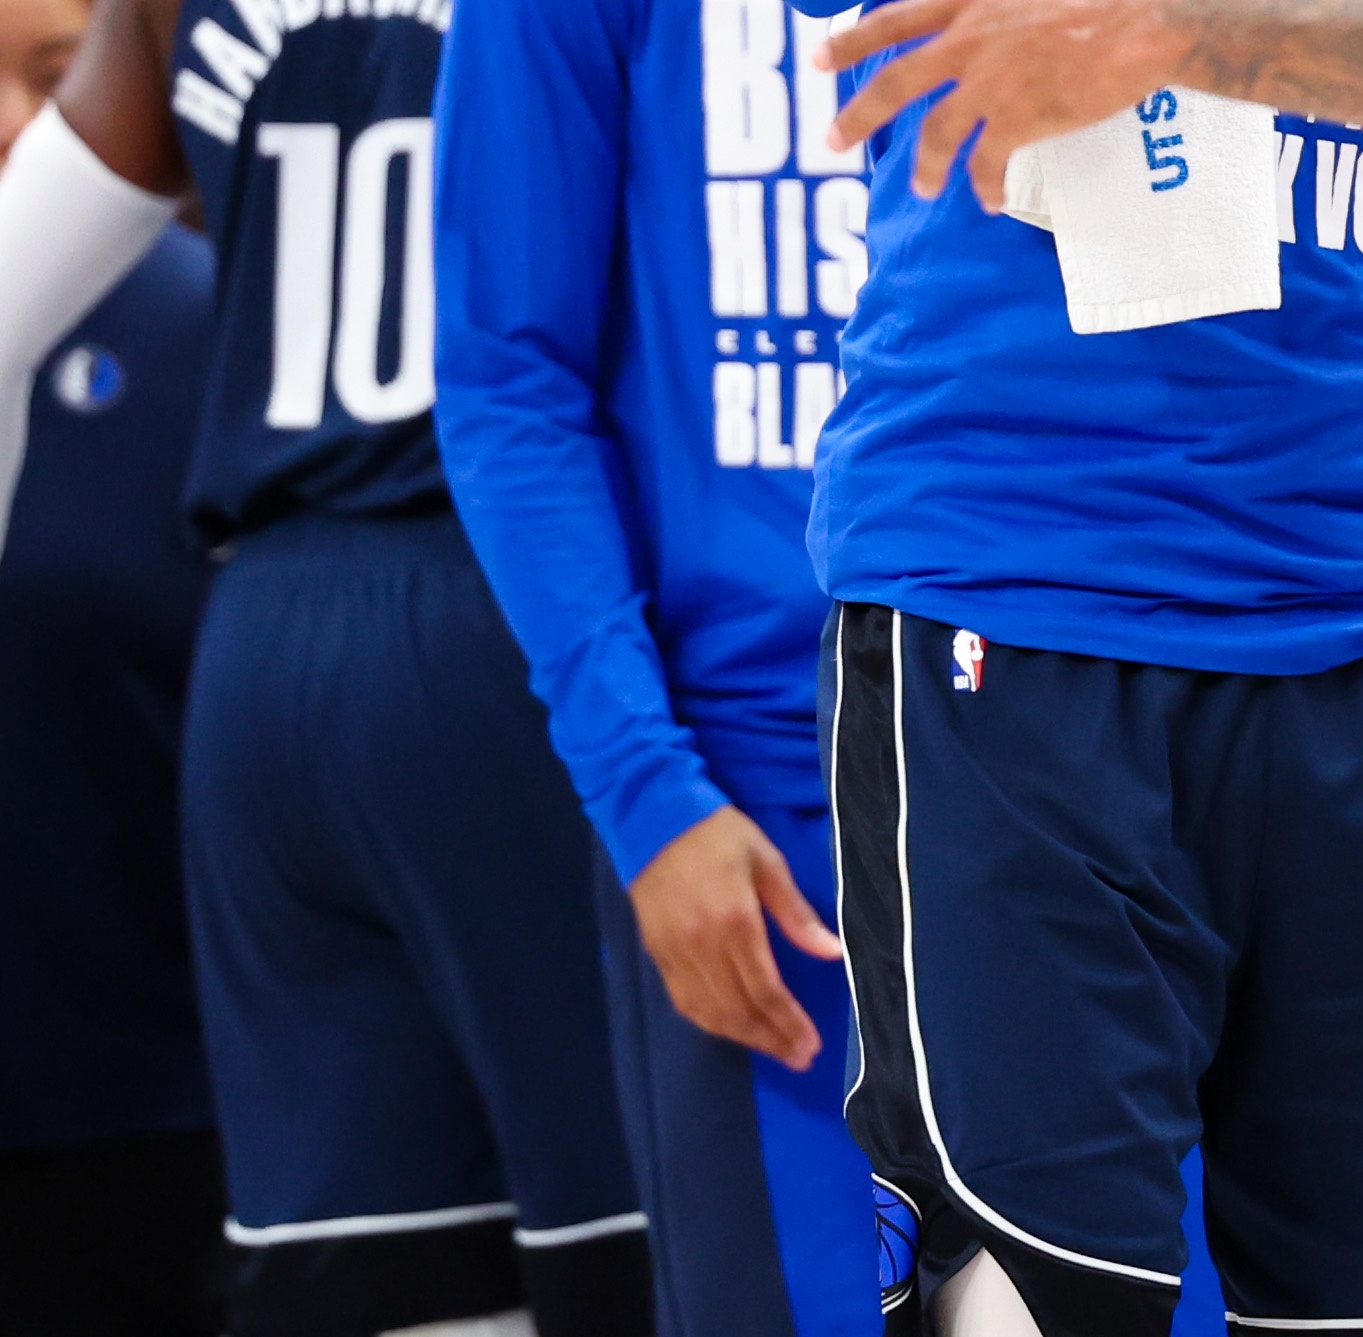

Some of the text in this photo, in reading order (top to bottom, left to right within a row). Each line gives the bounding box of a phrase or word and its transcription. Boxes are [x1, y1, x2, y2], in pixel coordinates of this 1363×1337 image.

[256, 117, 437, 429] 10
[715, 328, 845, 355] ELE
[713, 362, 846, 468] BLA
